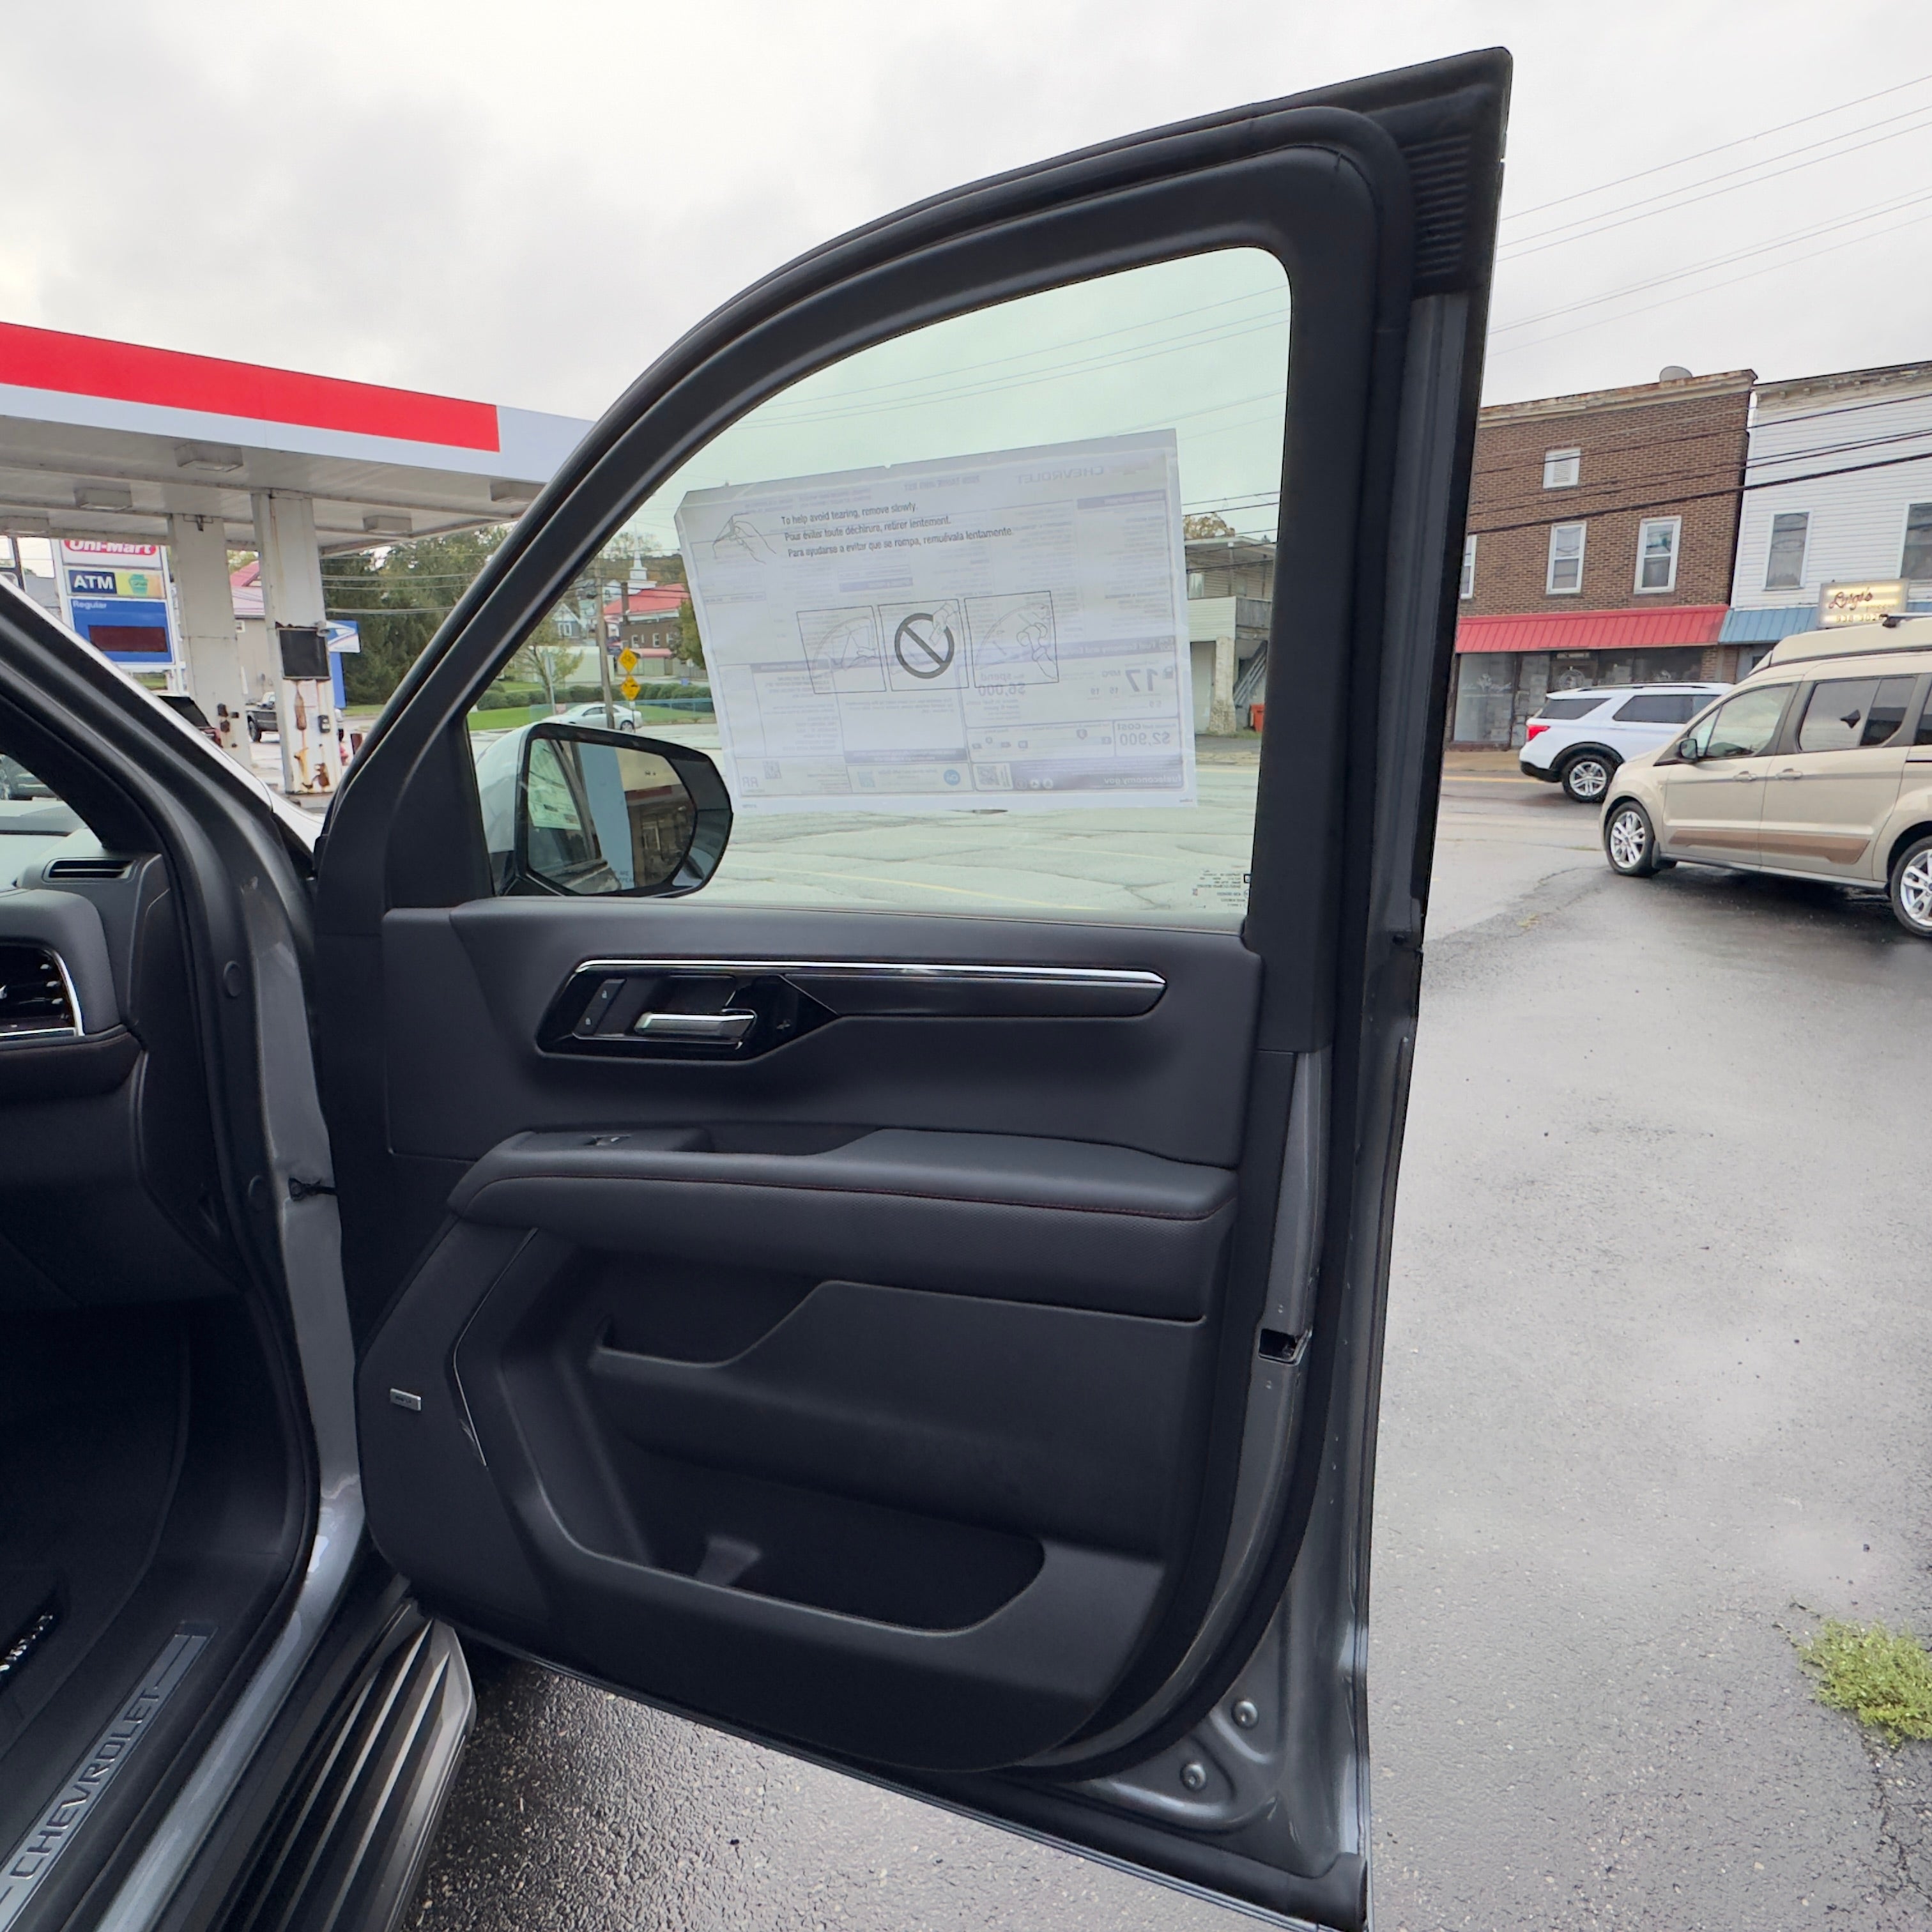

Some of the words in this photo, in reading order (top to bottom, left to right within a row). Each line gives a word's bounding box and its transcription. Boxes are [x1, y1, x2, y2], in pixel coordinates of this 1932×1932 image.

[781, 516, 791, 525] To
[792, 514, 808, 525] help
[810, 512, 830, 523] avoid
[831, 509, 861, 519] tearing,
[862, 506, 889, 516] remove
[785, 532, 801, 542] Pour
[802, 530, 823, 540] éviter
[824, 528, 843, 537] toute
[845, 525, 883, 535] déchirure,
[884, 519, 908, 530] retirer
[910, 516, 951, 528] lentement.
[68, 540, 152, 554] Uni-Mart
[788, 548, 804, 557] Para
[806, 546, 838, 557] ayudarse
[846, 542, 866, 553] evitar
[869, 541, 882, 552] que
[884, 540, 893, 548] se
[894, 537, 921, 548] rompa,
[74, 575, 113, 589] ATM
[72, 601, 107, 610] Regular
[10, 1689, 160, 1880] CHEVROLET
